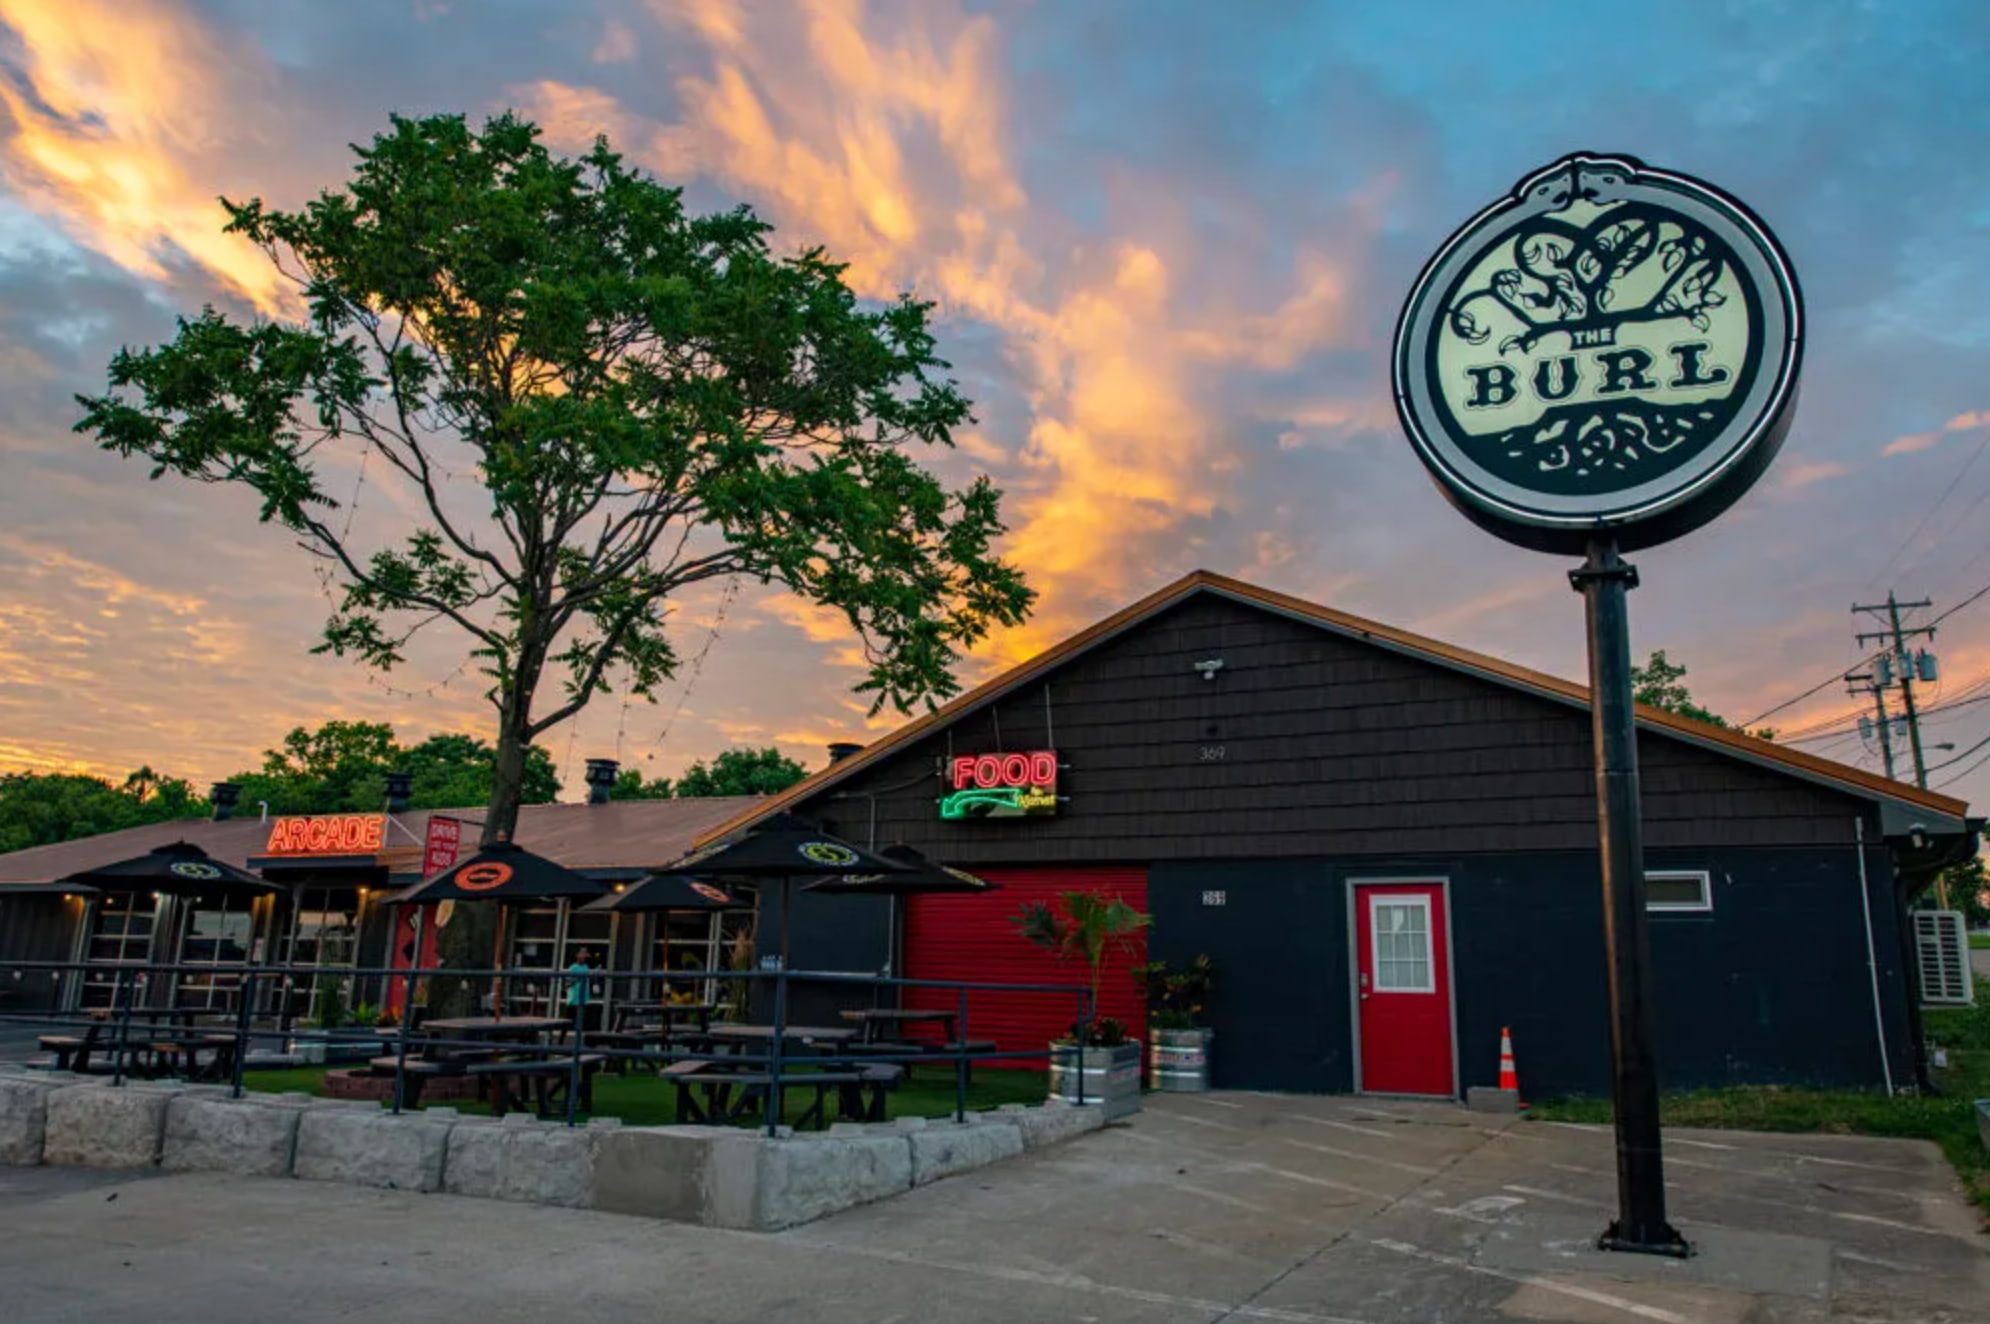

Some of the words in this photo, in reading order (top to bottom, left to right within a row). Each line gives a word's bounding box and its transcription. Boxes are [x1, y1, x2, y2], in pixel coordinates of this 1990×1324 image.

[1573, 329, 1613, 345] THE
[1465, 342, 1730, 407] BURL
[953, 752, 1056, 789] FOOD
[1200, 745, 1225, 761] 369
[266, 815, 388, 851] ARCADE
